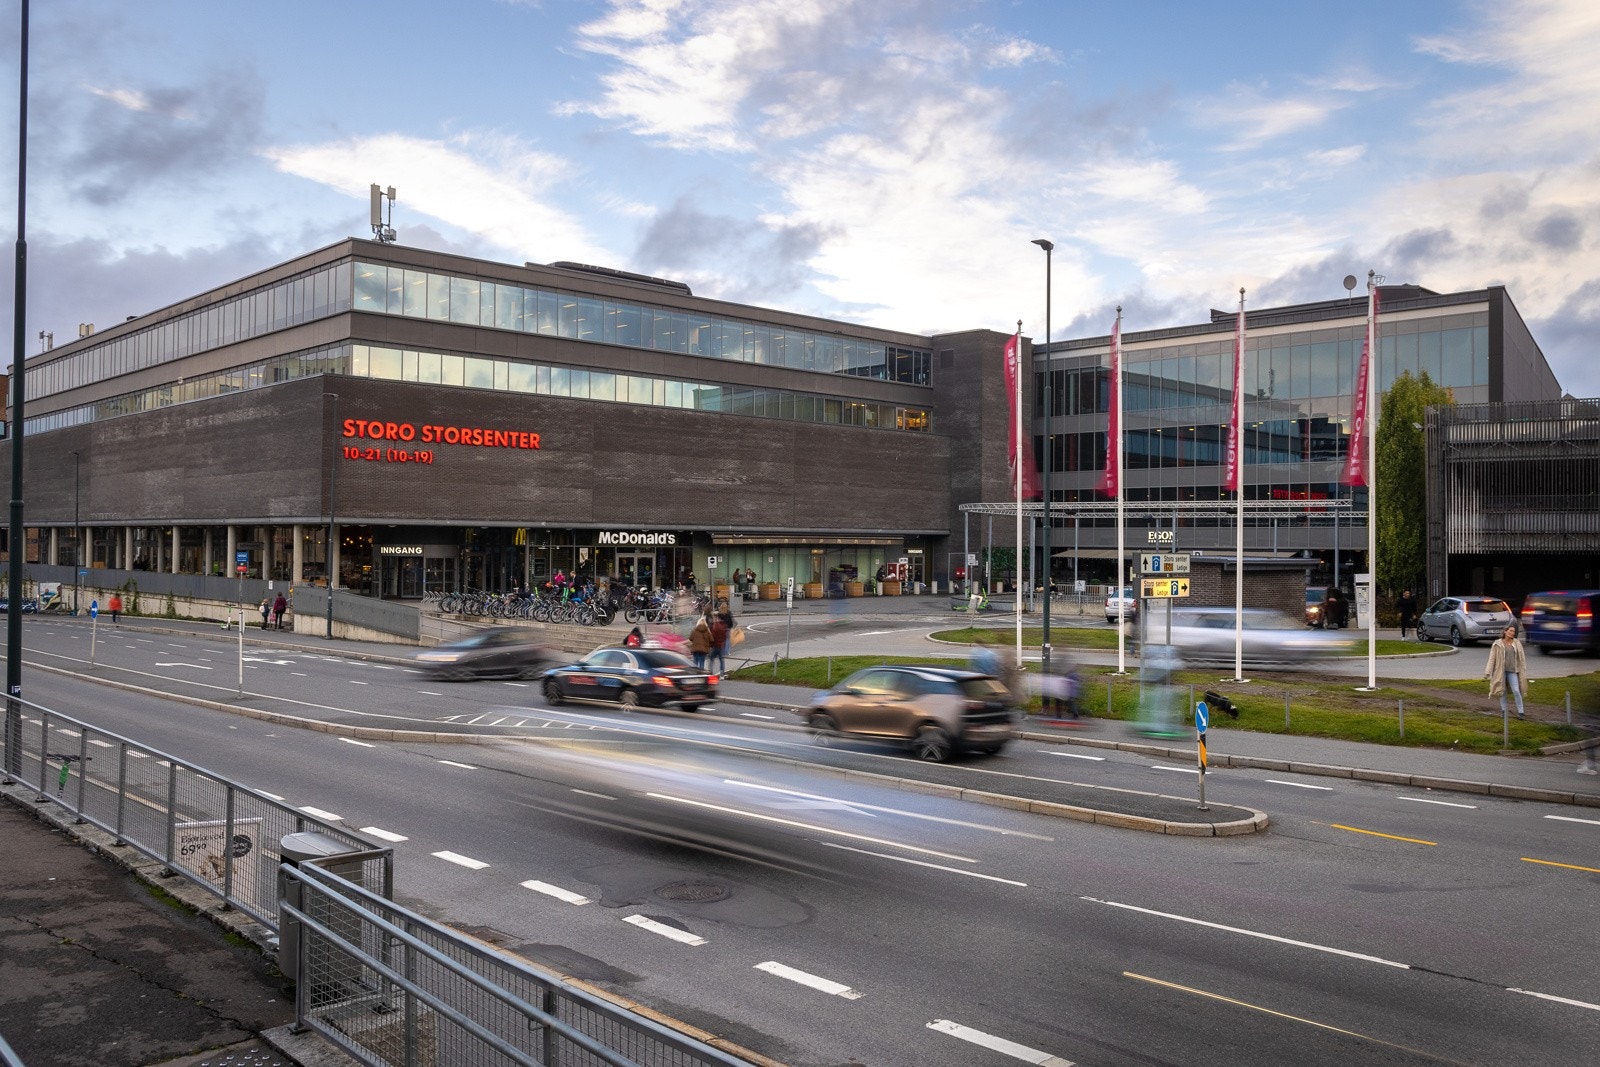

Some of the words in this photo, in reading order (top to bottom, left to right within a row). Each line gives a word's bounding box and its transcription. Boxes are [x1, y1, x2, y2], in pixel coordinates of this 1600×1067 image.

[343, 419, 415, 441] STORO
[421, 425, 541, 450] STORSENTER
[344, 446, 381, 461] 10-21
[386, 448, 433, 464] (10-19)
[598, 532, 676, 545] McDonald's
[380, 547, 423, 555] INNGANG
